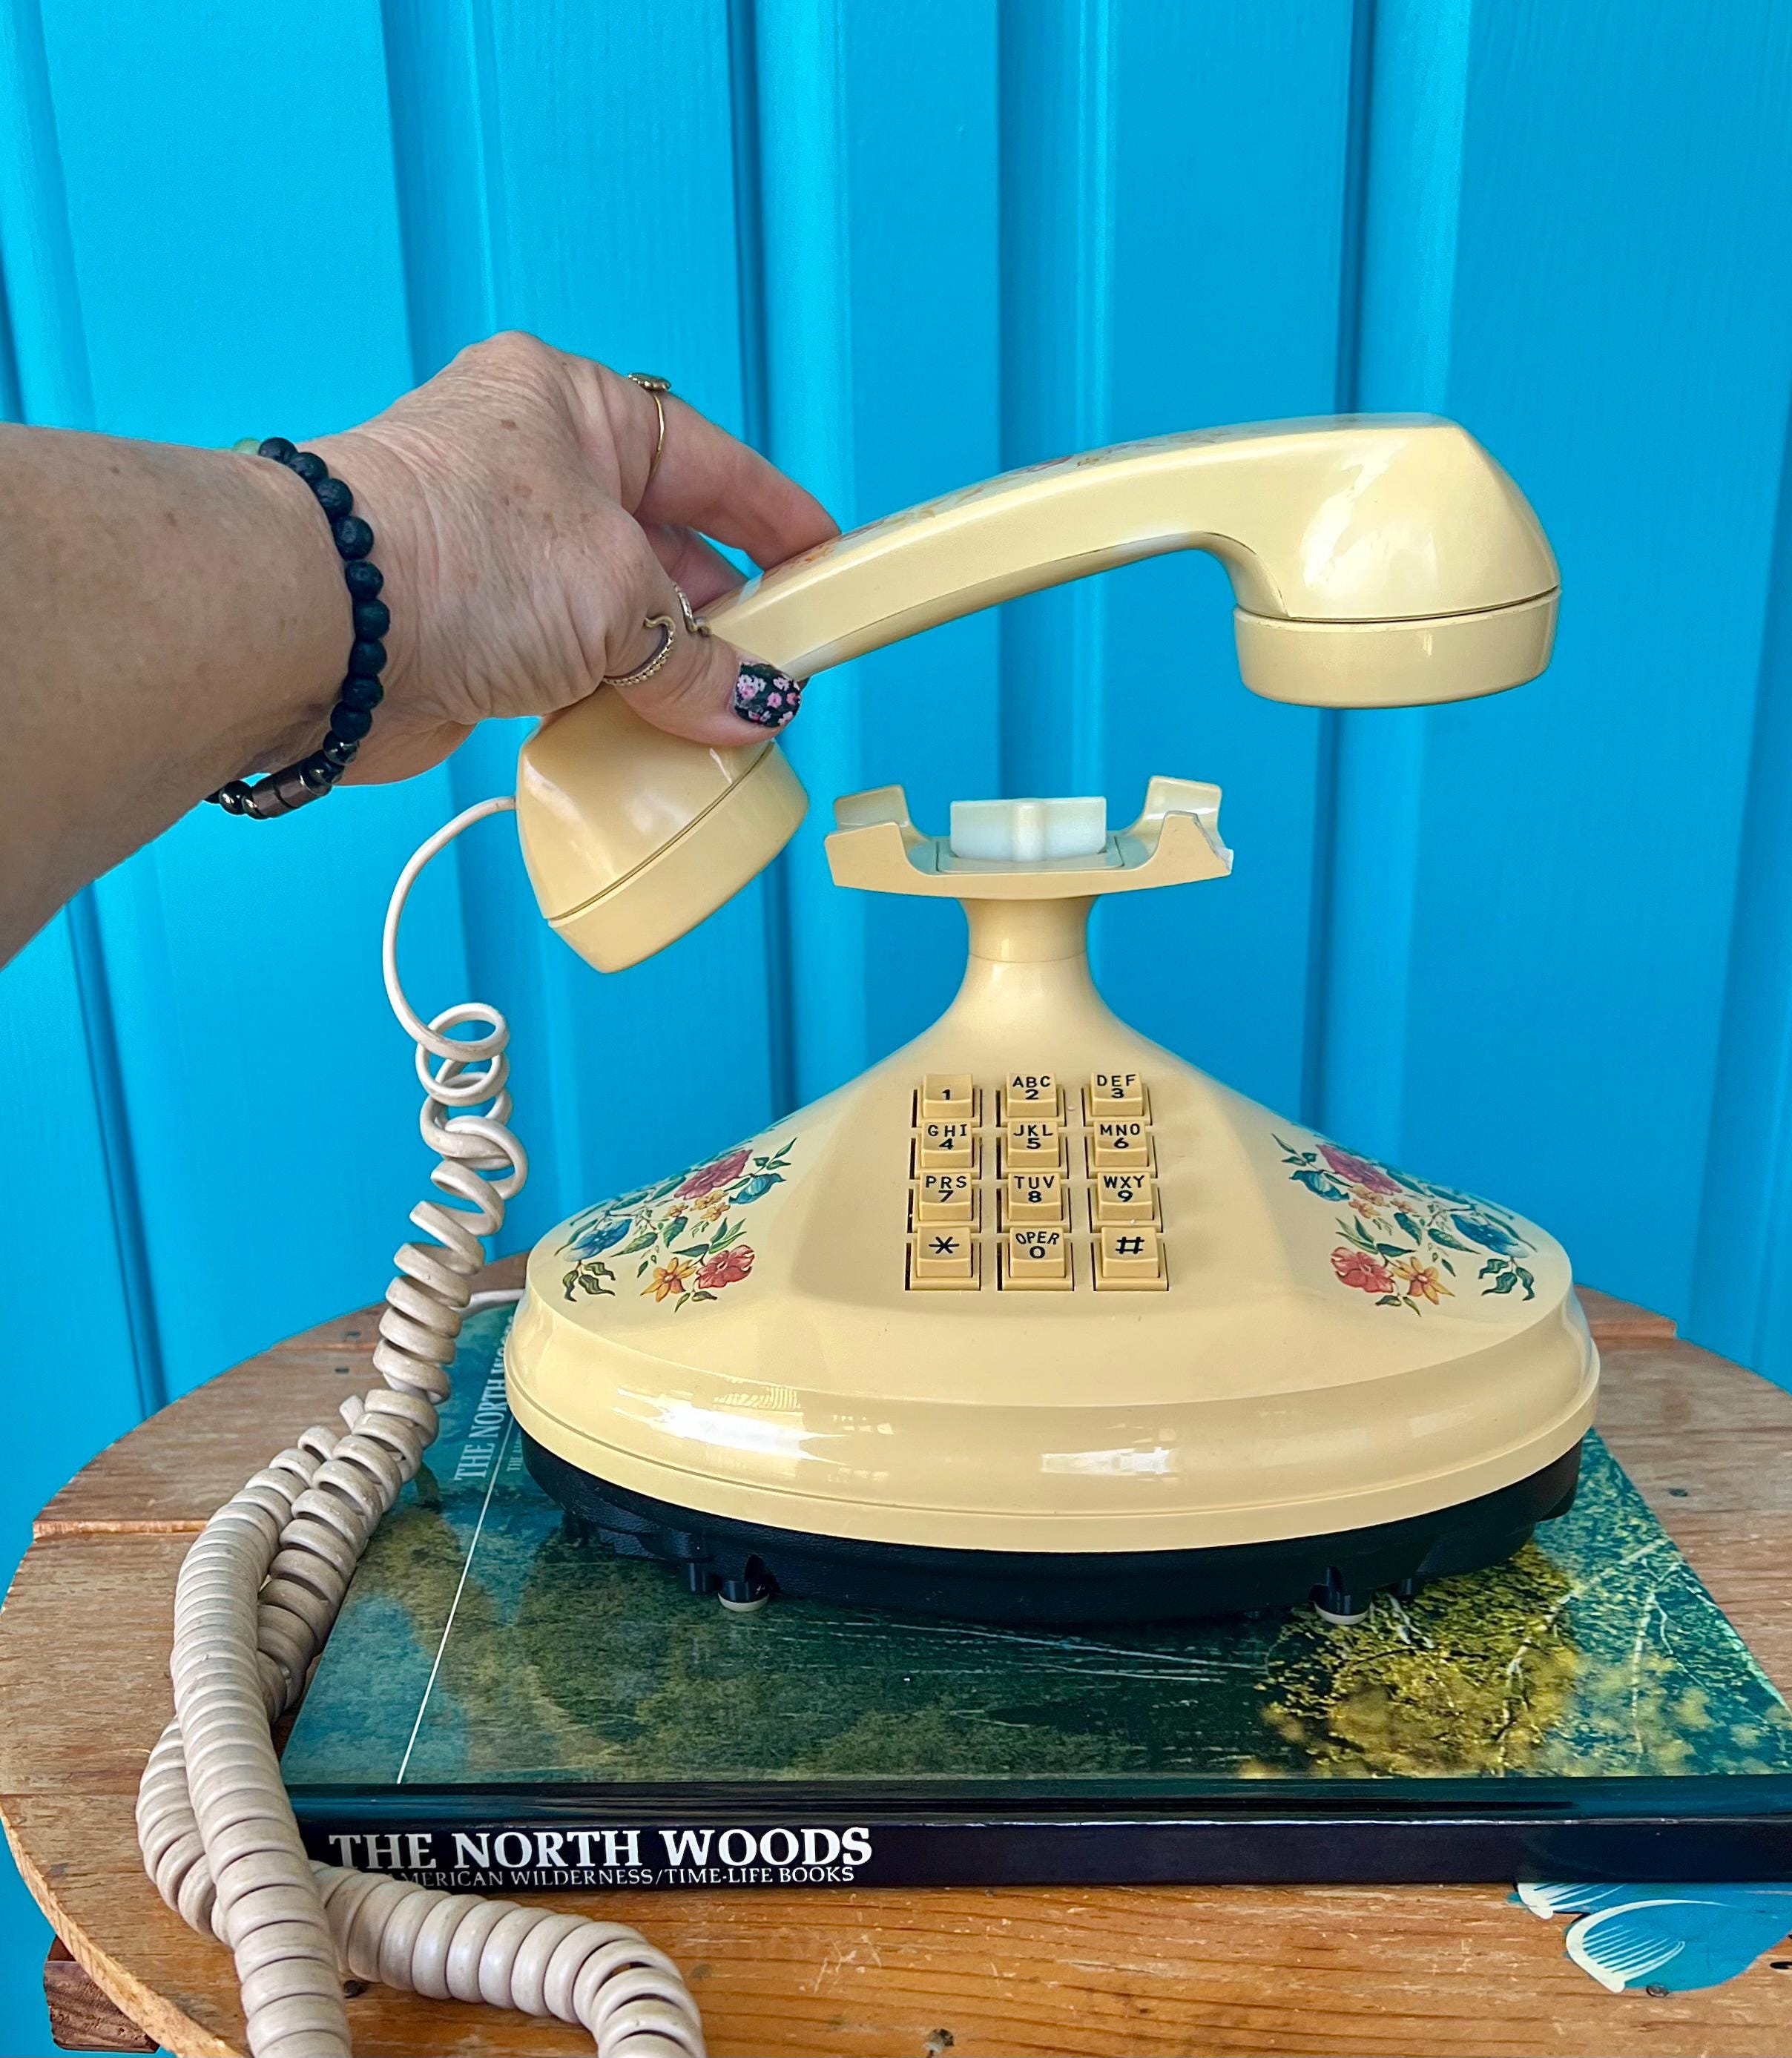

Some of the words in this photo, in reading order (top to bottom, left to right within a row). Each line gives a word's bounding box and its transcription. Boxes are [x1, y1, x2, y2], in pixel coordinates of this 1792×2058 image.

[1012, 1075, 1051, 1088] ABC
[1096, 1074, 1136, 1087] DEF
[942, 1089, 951, 1101] 1
[1024, 1089, 1039, 1101] 2
[1111, 1087, 1124, 1099] 3
[927, 1124, 968, 1137] GHI
[1013, 1124, 1053, 1137] JKL
[1099, 1123, 1141, 1136] MNO
[938, 1138, 955, 1150] 4
[1026, 1137, 1041, 1150] 5
[1113, 1137, 1130, 1150] 6
[925, 1175, 967, 1189] PRS
[1013, 1175, 1055, 1190] TUV
[1103, 1175, 1145, 1189] WXY
[938, 1190, 954, 1203] 7
[1027, 1190, 1042, 1204] 8
[1117, 1190, 1133, 1203] 9
[1015, 1230, 1060, 1245] OPER
[468, 1379, 507, 1439] NORTH
[453, 1442, 495, 1481] THE
[329, 1833, 437, 1870] THE
[451, 1830, 643, 1868] NORTH
[659, 1827, 873, 1867] WOODS
[401, 1870, 504, 1887] MERICAN
[780, 1866, 855, 1883] BOOKS
